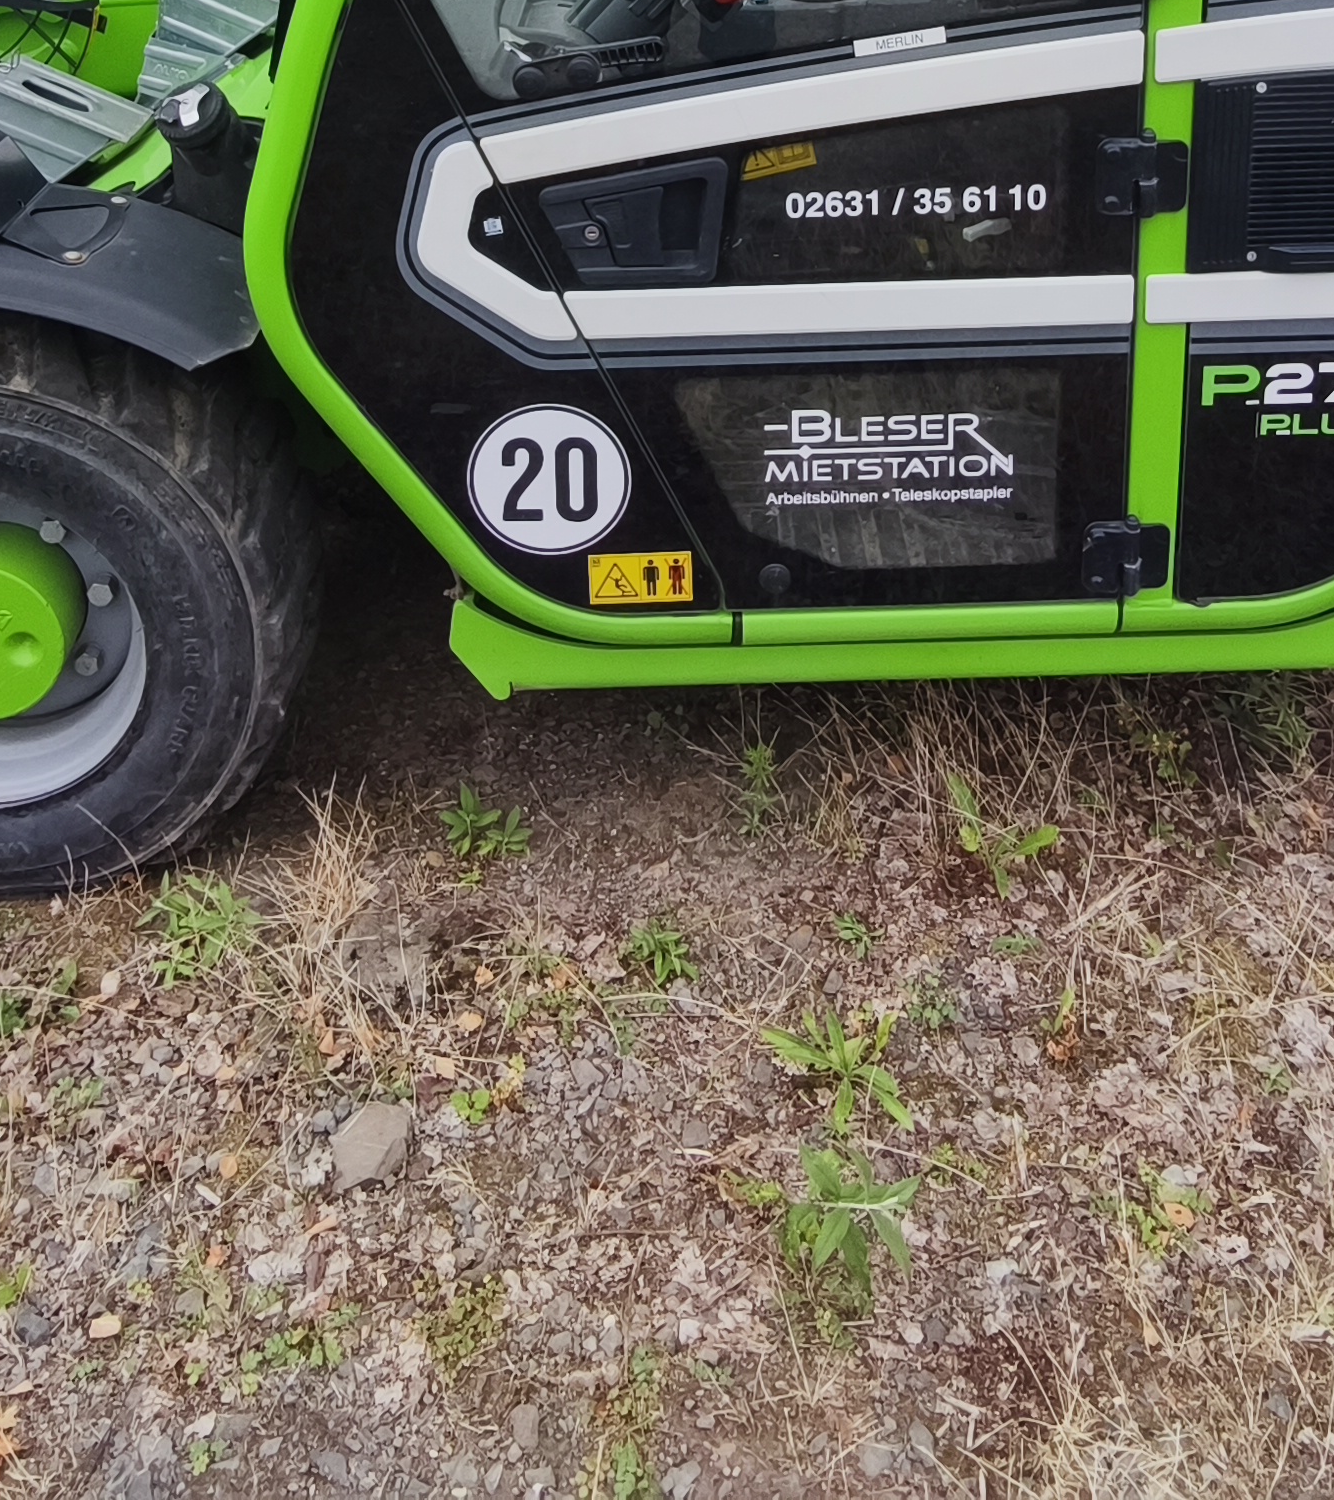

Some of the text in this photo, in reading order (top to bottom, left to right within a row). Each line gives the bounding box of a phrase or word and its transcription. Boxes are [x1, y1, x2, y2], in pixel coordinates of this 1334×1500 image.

[875, 33, 924, 51] MERLIN
[785, 189, 879, 219] 02631
[913, 186, 952, 215] 35
[962, 185, 997, 213] 61
[1008, 183, 1047, 211] 10
[791, 409, 981, 450] BLESER
[501, 436, 599, 522] 20
[764, 453, 1014, 483] MIETSTATION
[765, 485, 1014, 506] Arbeitsbühnen Teleskopstapler
